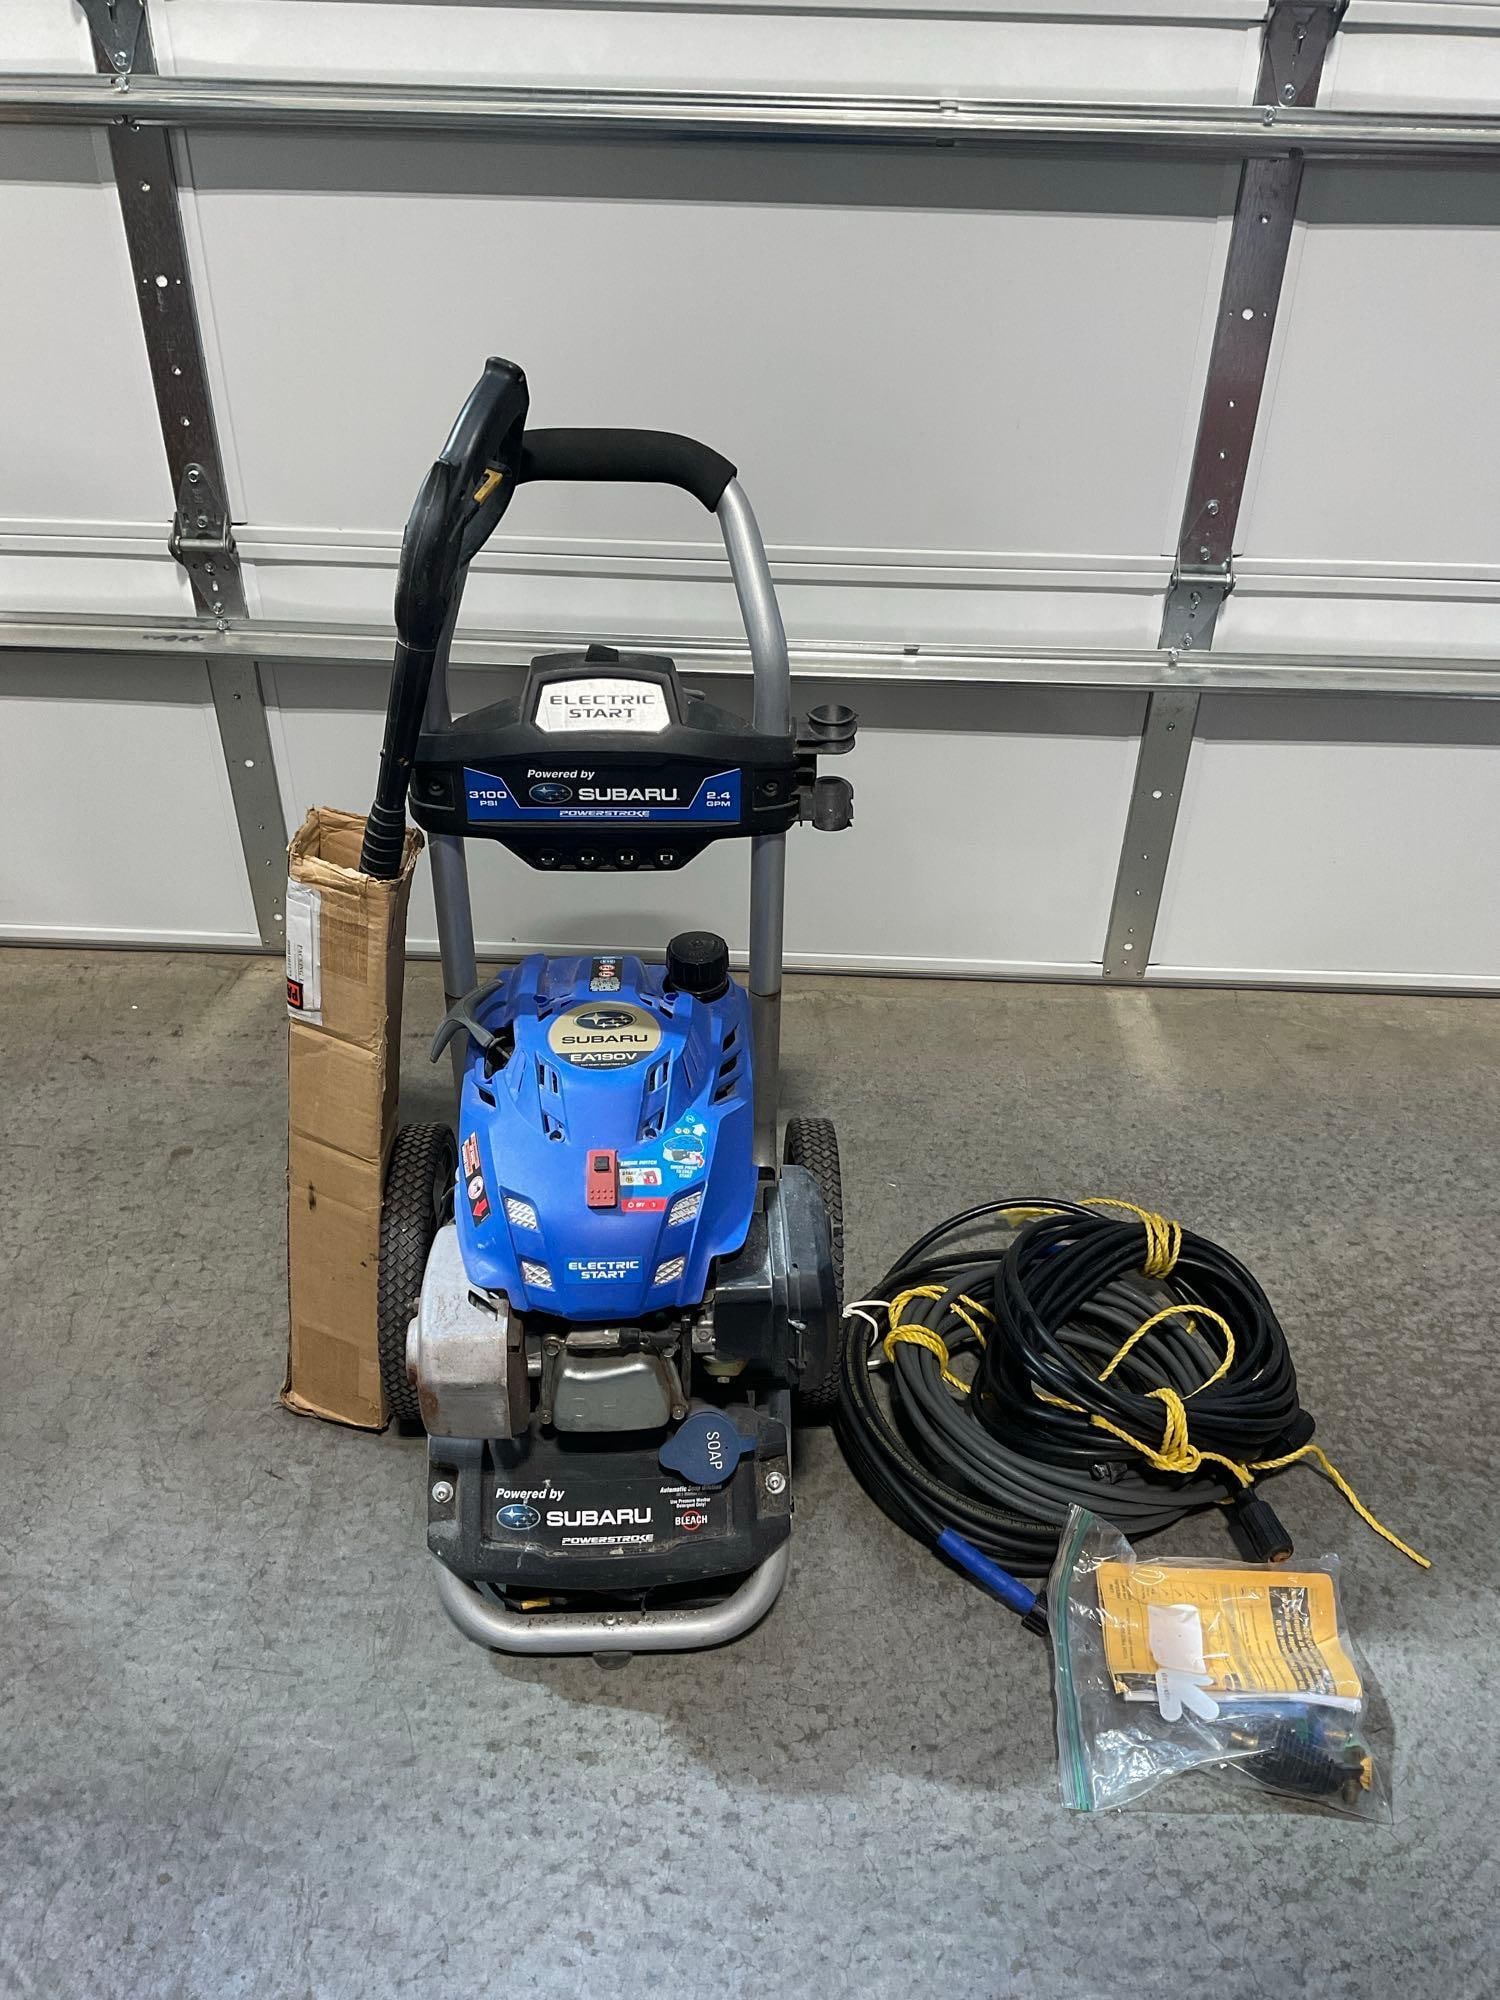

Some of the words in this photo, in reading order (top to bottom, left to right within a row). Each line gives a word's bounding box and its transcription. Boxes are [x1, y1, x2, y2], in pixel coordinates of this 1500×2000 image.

[549, 694, 656, 706] ELECTRIC
[568, 707, 636, 719] START
[527, 769, 577, 779] Powered
[580, 769, 595, 781] by
[469, 790, 508, 800] 3100
[578, 787, 679, 802] SUBARU
[706, 791, 731, 800] 2.4
[559, 810, 650, 818] POWERSTROKE
[561, 1033, 649, 1045] SUBARU
[570, 1052, 637, 1062] EA190V
[567, 1260, 640, 1270] ELECTRIC
[580, 1269, 627, 1279] START
[706, 1431, 723, 1471] SOAP
[495, 1487, 547, 1500] Powered
[549, 1488, 565, 1502] by
[659, 1485, 687, 1494] Automatic
[546, 1508, 652, 1527] SUBARU
[675, 1515, 708, 1526] BLEACH
[561, 1534, 654, 1546] POWERSTROKE
